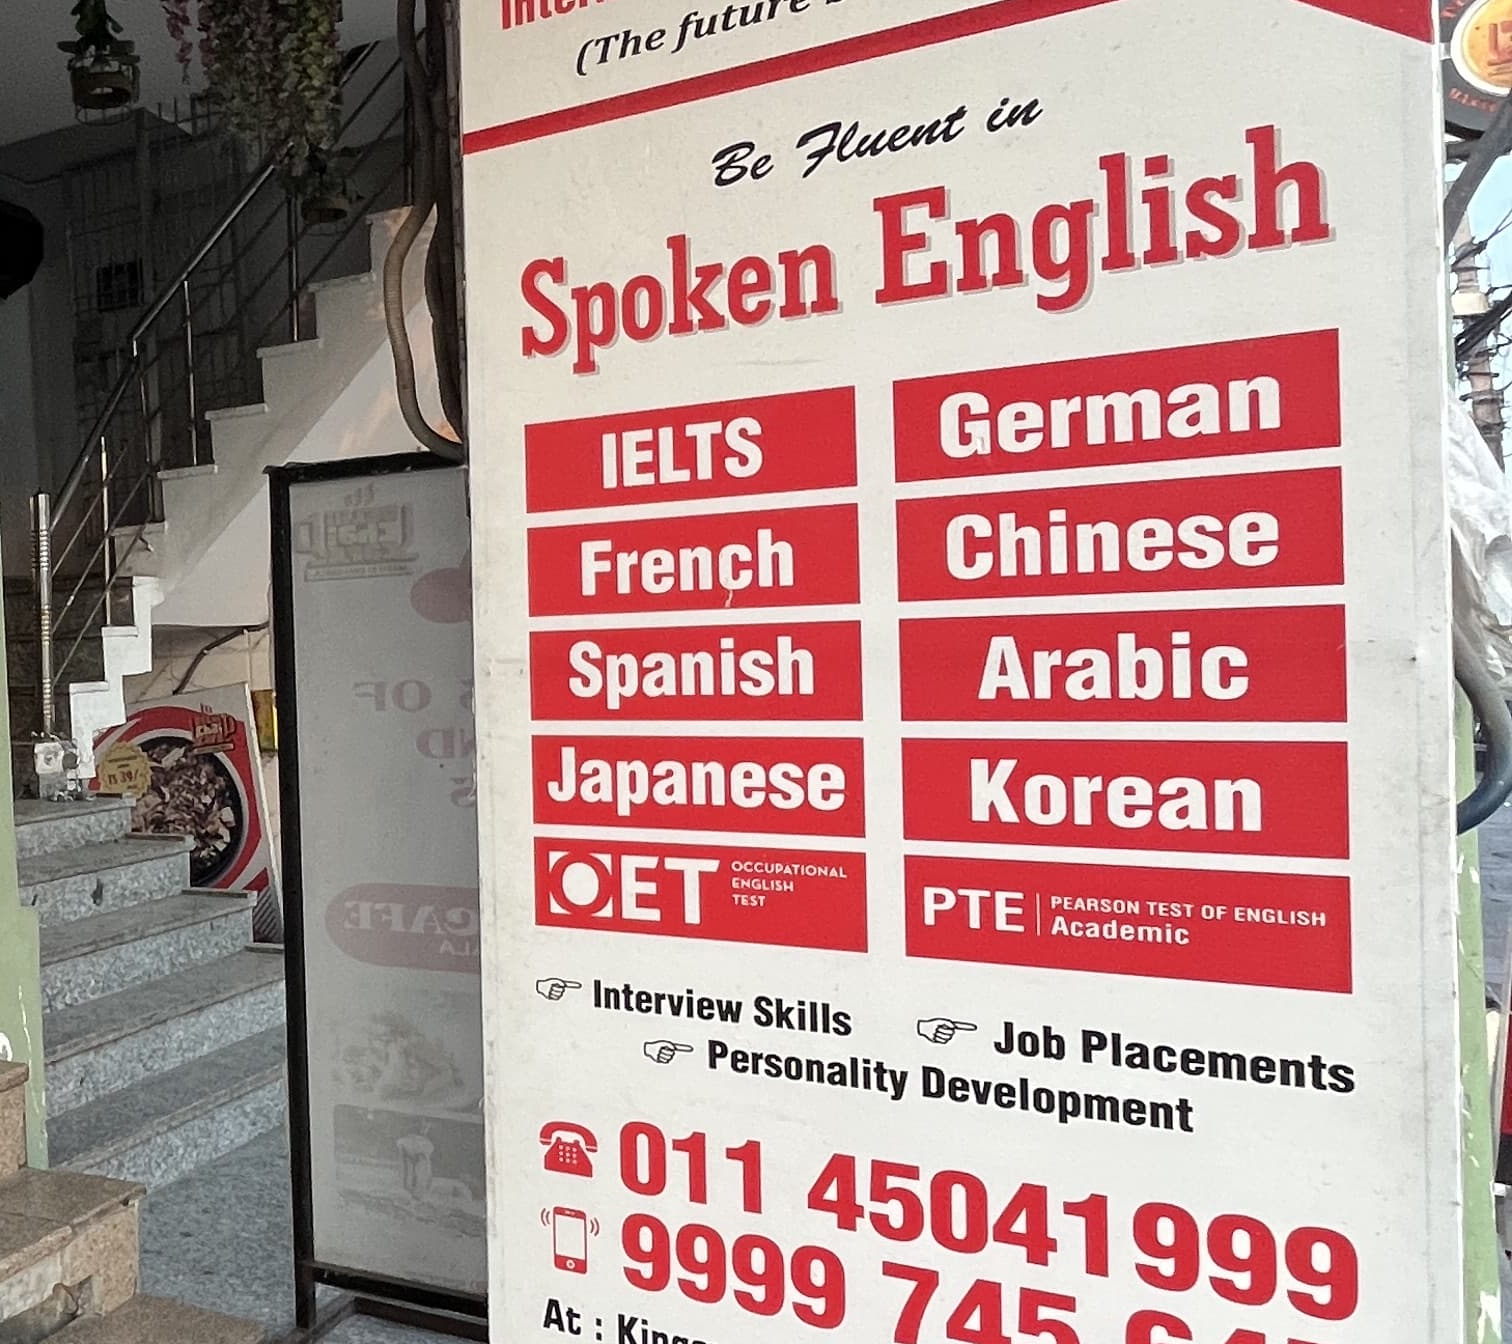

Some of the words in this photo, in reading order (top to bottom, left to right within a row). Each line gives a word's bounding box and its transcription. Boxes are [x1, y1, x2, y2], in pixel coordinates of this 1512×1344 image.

[574, 26, 666, 77] (The
[712, 141, 774, 188] Be
[796, 106, 968, 179] Fluent
[986, 94, 1043, 131] in
[521, 235, 838, 374] Spoken
[872, 125, 1332, 313] English
[938, 373, 1281, 459] German
[601, 416, 763, 490] IELTS
[580, 528, 794, 596] French
[945, 507, 1280, 580] Chinese
[568, 637, 816, 710] Spanish
[977, 632, 1249, 702] Arabic
[547, 746, 846, 817] Japanese
[968, 758, 1263, 832] Korean
[731, 860, 848, 878] OCCUPATIONAL
[732, 877, 794, 892] ENGLISH
[732, 894, 766, 907] TEST
[923, 886, 1026, 933] PTE
[1050, 895, 1140, 916] PEARSON
[1146, 900, 1195, 918] TEST
[1200, 904, 1229, 920] OF
[1234, 908, 1327, 927] ENGLISH
[1050, 916, 1190, 946] Academic
[591, 979, 743, 1025] Interview
[752, 994, 852, 1037] Skills
[707, 1042, 908, 1101] Personality
[921, 1066, 1194, 1133] Development
[993, 1020, 1066, 1062] Job
[1082, 1031, 1356, 1095] Placements
[619, 1120, 765, 1214] 011
[807, 1153, 1360, 1323] 45041999
[622, 1213, 846, 1331] 9999
[541, 1298, 582, 1335] At
